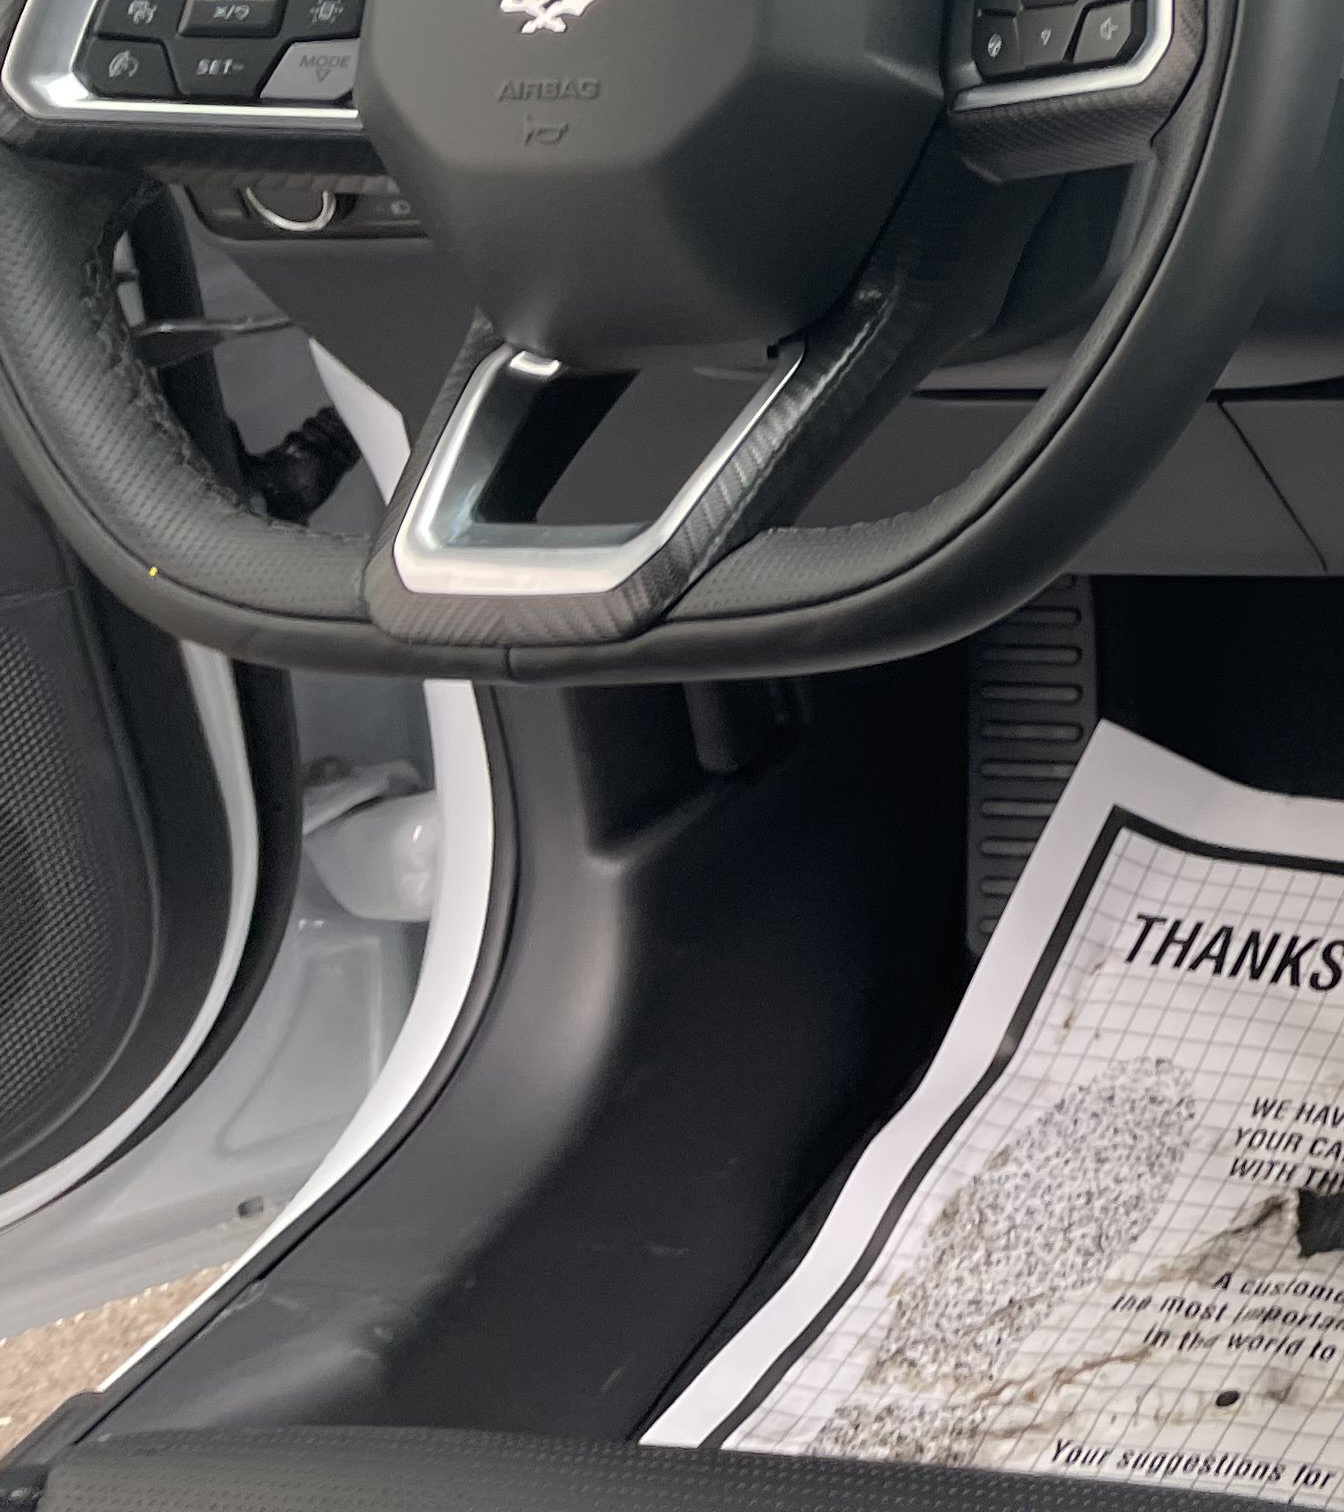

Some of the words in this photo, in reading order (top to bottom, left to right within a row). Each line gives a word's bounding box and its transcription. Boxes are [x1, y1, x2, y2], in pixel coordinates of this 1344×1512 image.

[300, 54, 350, 69] MODE
[498, 79, 601, 102] AIRBAG
[1250, 1096, 1293, 1121] WE
[1233, 1127, 1302, 1154] YOUR
[1229, 1156, 1297, 1182] WITH
[1212, 1271, 1234, 1290] A
[1111, 1293, 1153, 1312] the
[1159, 1295, 1227, 1322] most
[1143, 1322, 1171, 1347] in
[1177, 1329, 1217, 1353] the
[1227, 1332, 1304, 1358] world
[1309, 1339, 1336, 1362] to
[1049, 1437, 1112, 1467] Your
[1116, 1447, 1287, 1483] suggestions
[1291, 1462, 1336, 1490] for
